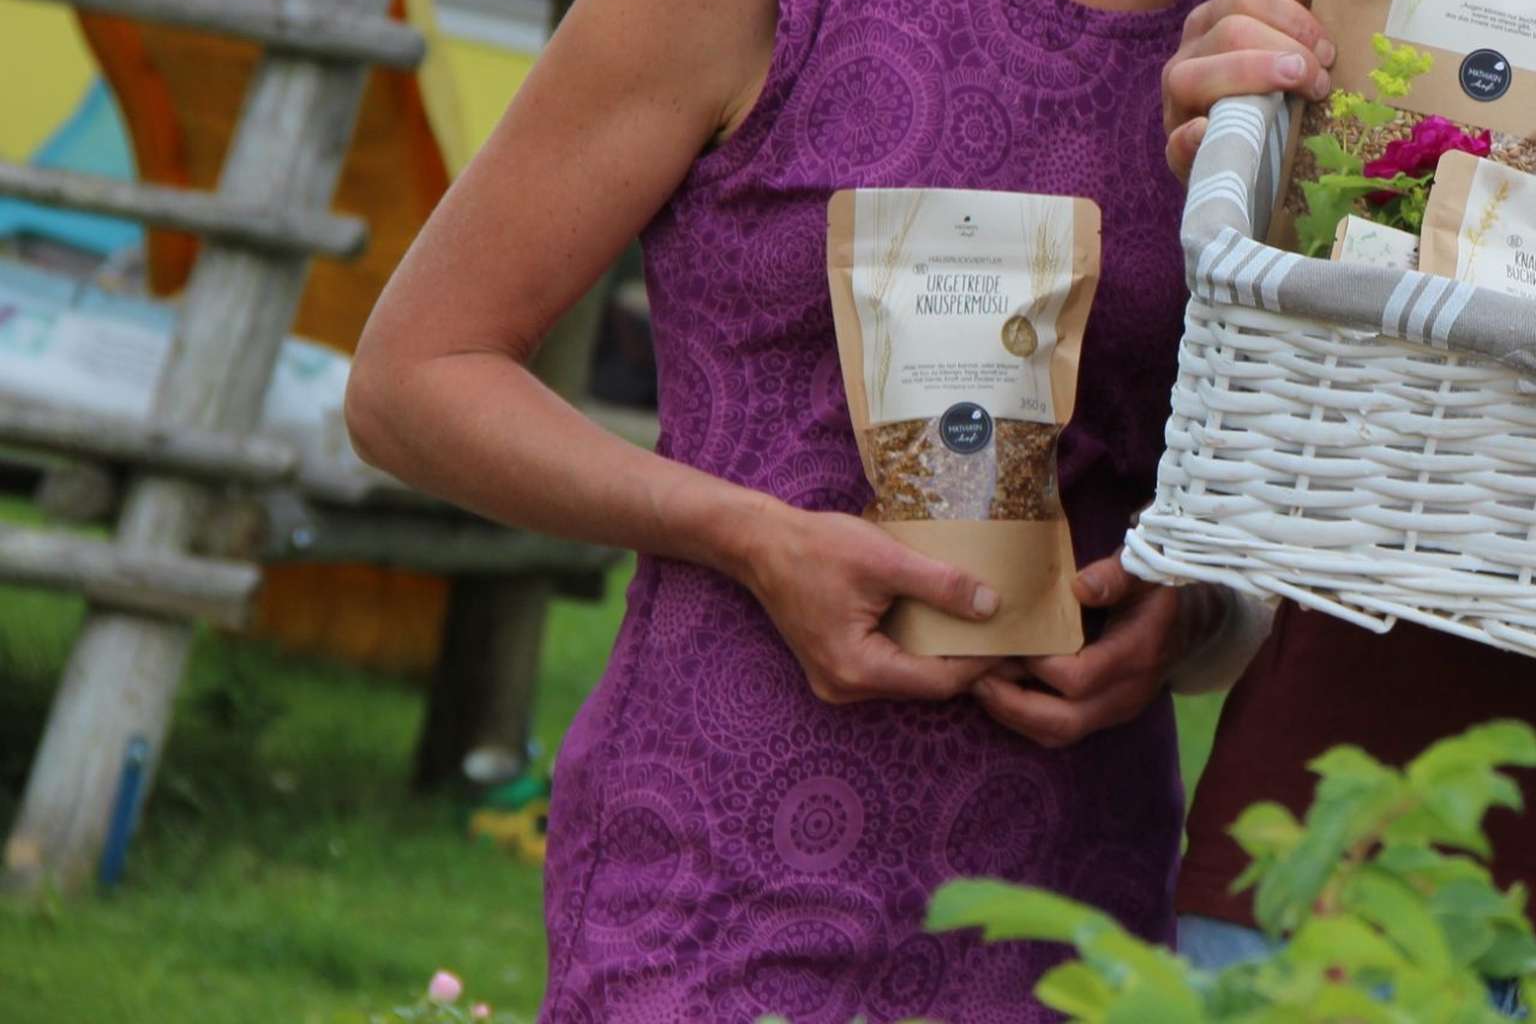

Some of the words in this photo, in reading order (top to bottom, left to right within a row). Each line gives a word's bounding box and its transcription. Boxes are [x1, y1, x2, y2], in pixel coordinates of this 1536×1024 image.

[927, 274, 1001, 294] URGETREIDE
[1020, 397, 1039, 410] 350
[1039, 401, 1047, 413] g
